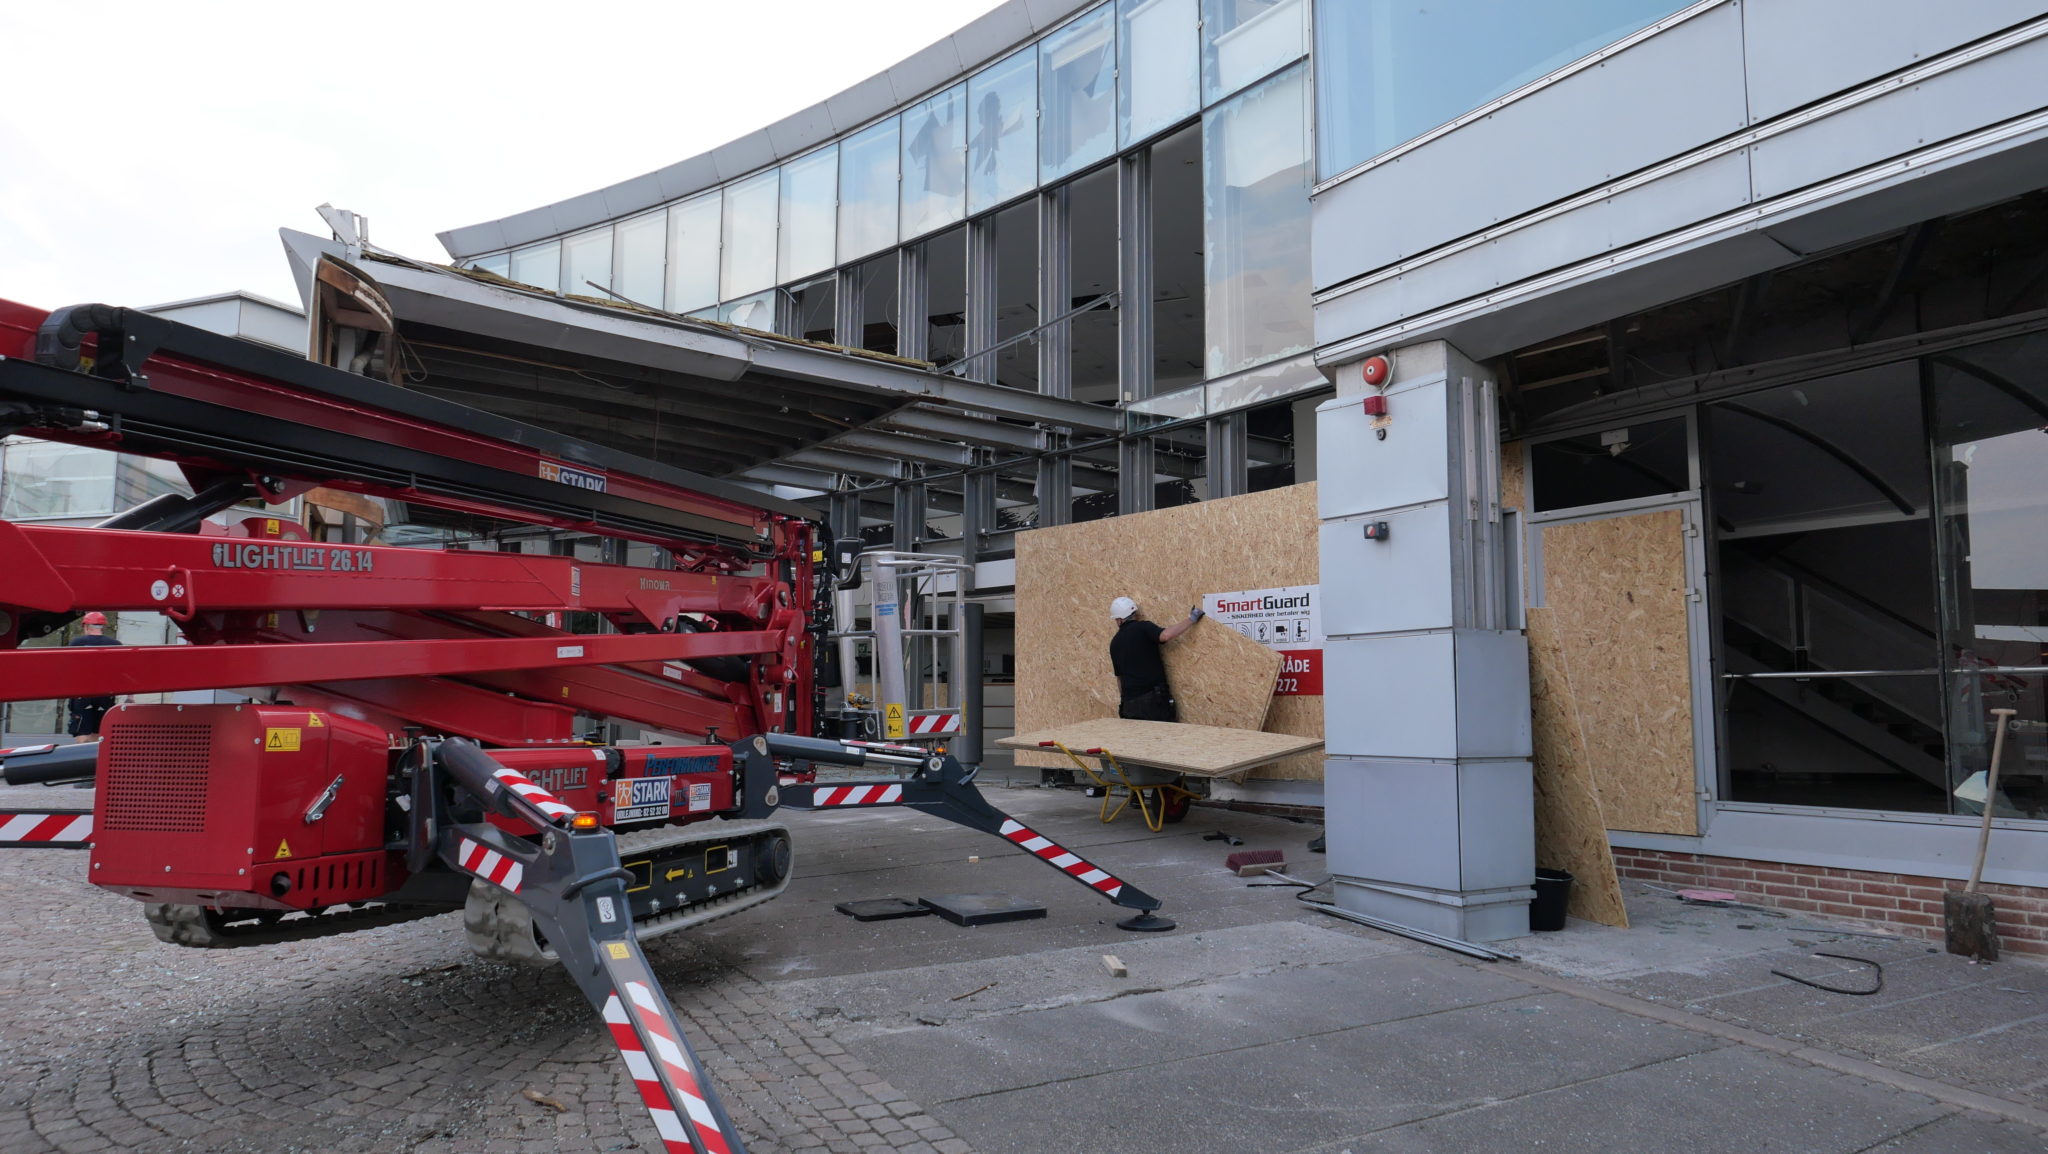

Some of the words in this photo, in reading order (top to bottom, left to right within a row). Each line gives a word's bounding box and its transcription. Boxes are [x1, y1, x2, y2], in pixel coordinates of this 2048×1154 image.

[222, 543, 325, 570] LIGHTLIFT
[330, 549, 373, 572] 26.14
[1217, 592, 1310, 613] SmartGuard
[1279, 655, 1310, 673] RÅDE
[1277, 678, 1298, 692] 272
[522, 767, 588, 791] GHTLIFT
[633, 780, 668, 803] STARK
